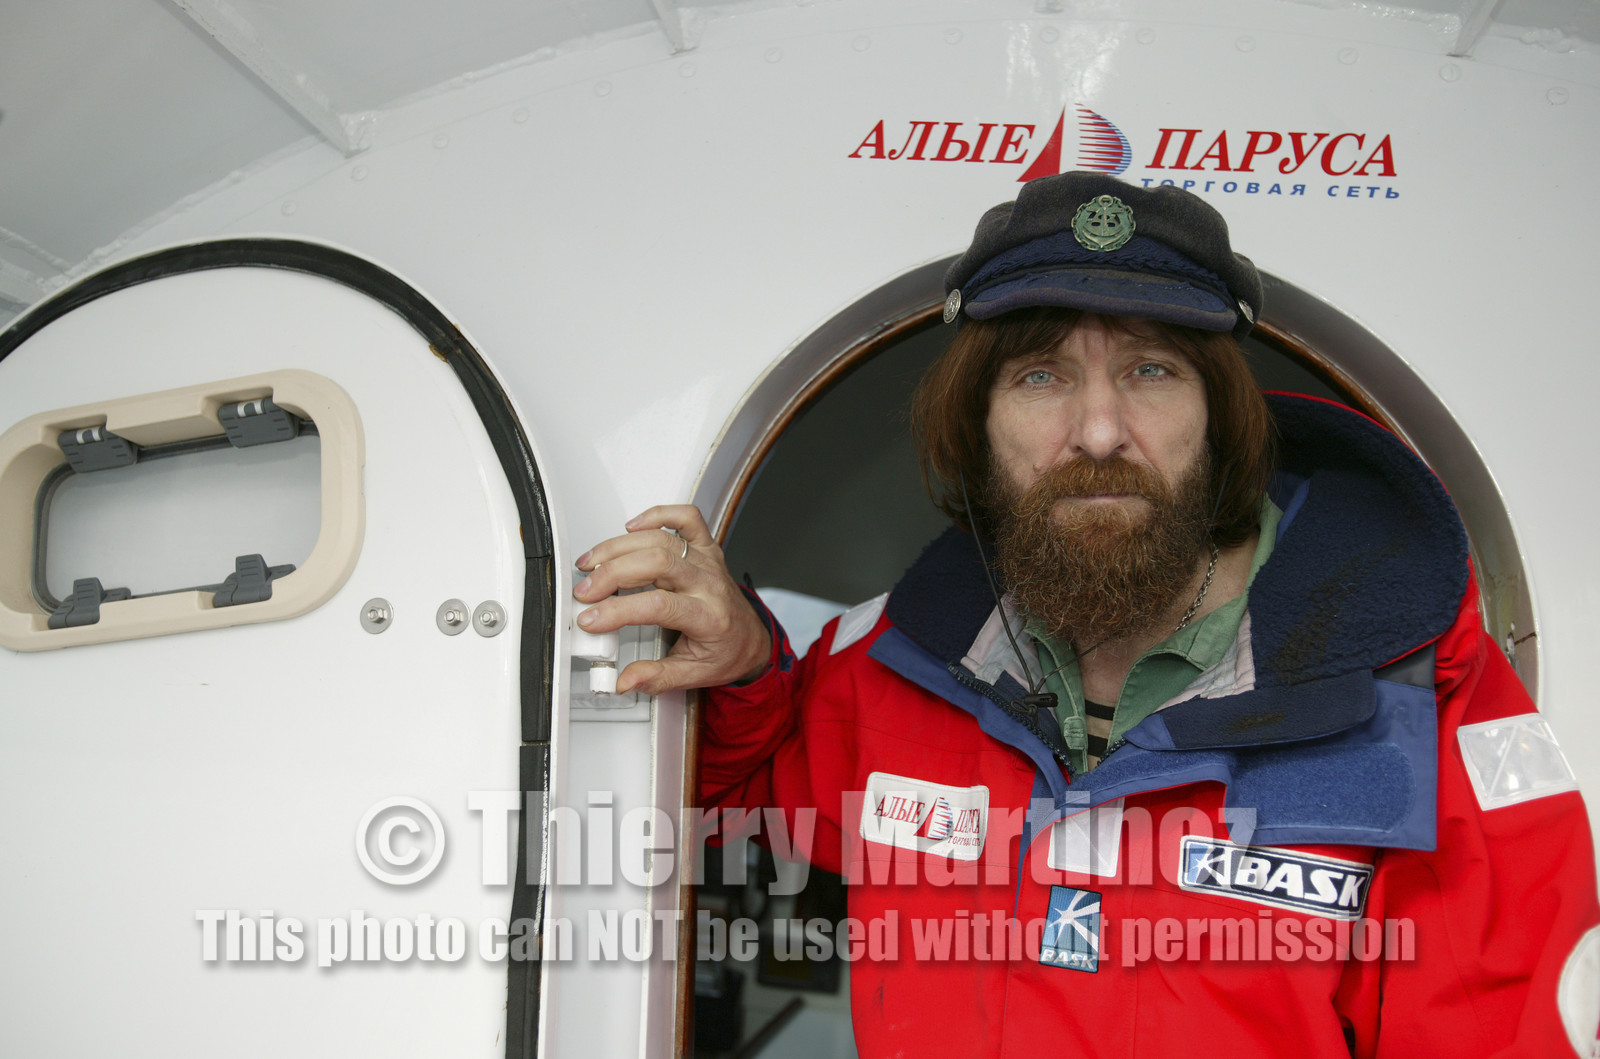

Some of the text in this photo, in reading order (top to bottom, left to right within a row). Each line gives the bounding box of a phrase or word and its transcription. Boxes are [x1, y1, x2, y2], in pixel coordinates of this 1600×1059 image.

[848, 119, 1398, 177] АЛЫЕ ПАРУСА
[1327, 184, 1401, 199] СЕТЬ
[873, 794, 926, 825] АЛЫЕ
[1234, 855, 1367, 908] BASK
[1041, 948, 1097, 970] BASK
